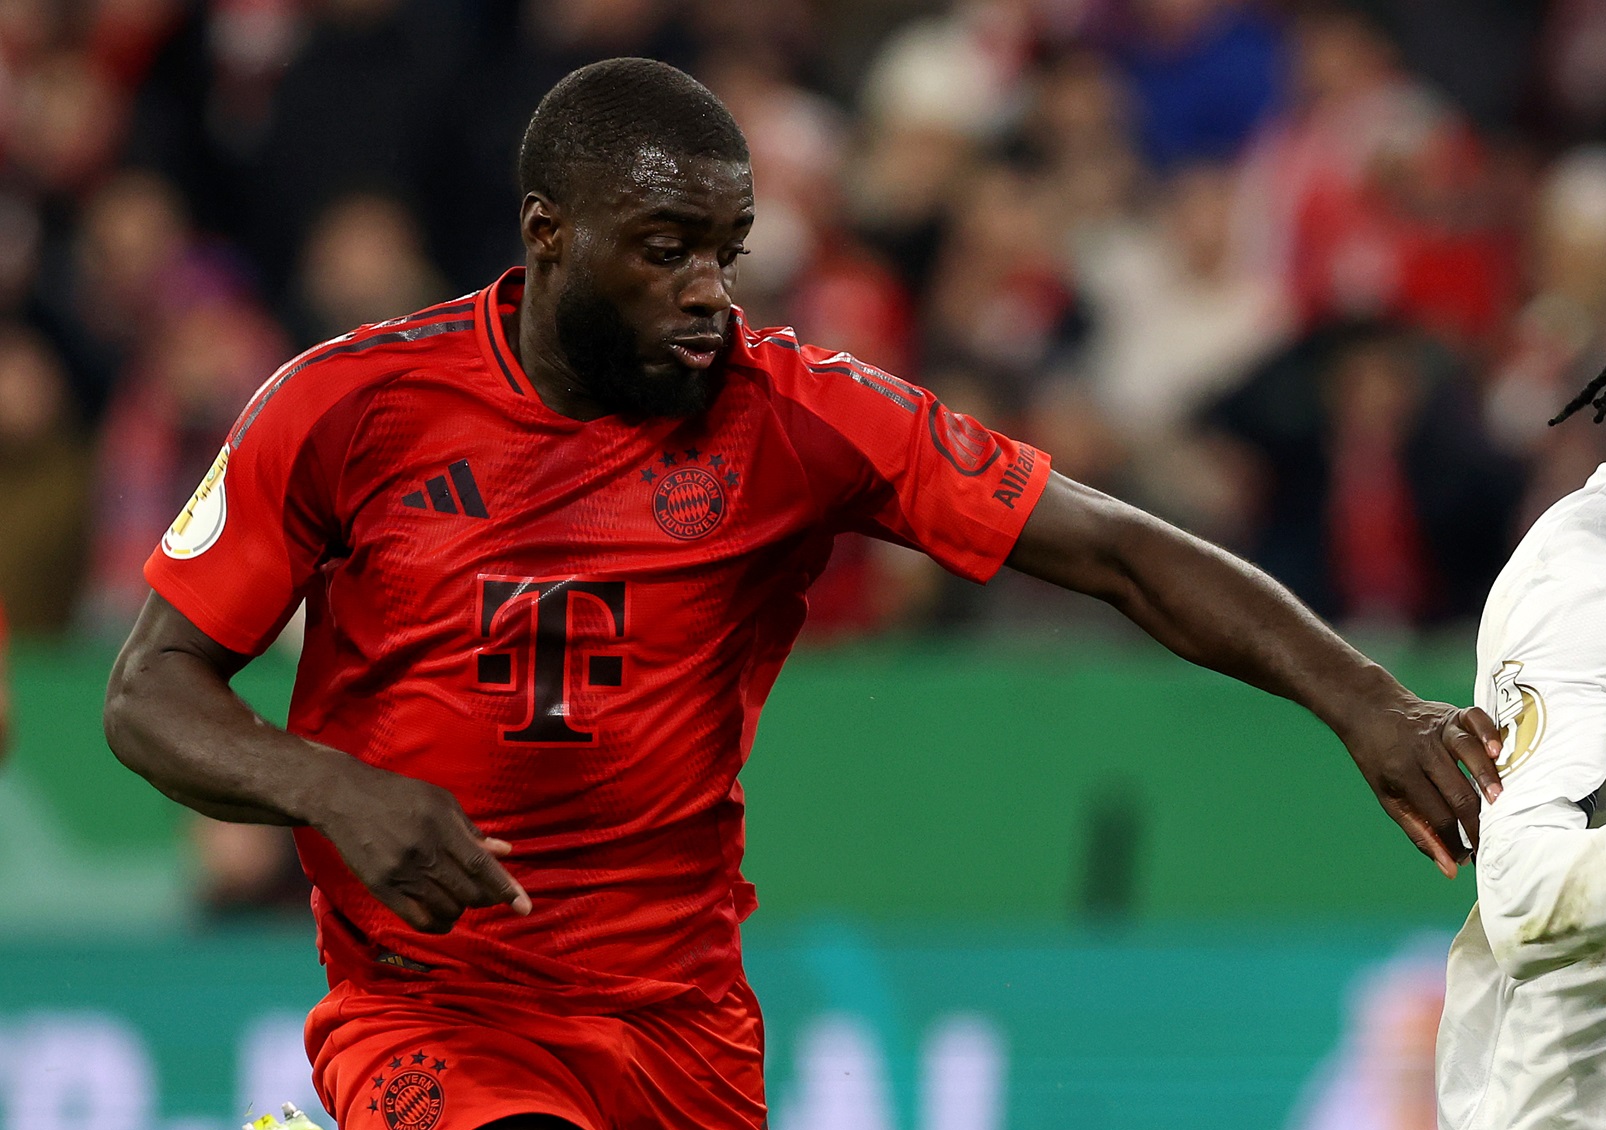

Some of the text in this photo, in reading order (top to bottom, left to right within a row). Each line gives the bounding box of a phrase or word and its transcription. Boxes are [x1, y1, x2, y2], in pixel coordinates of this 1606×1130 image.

[659, 472, 719, 499] FC BAYERN
[476, 574, 631, 748] T
[390, 1075, 434, 1094] BAYERN
